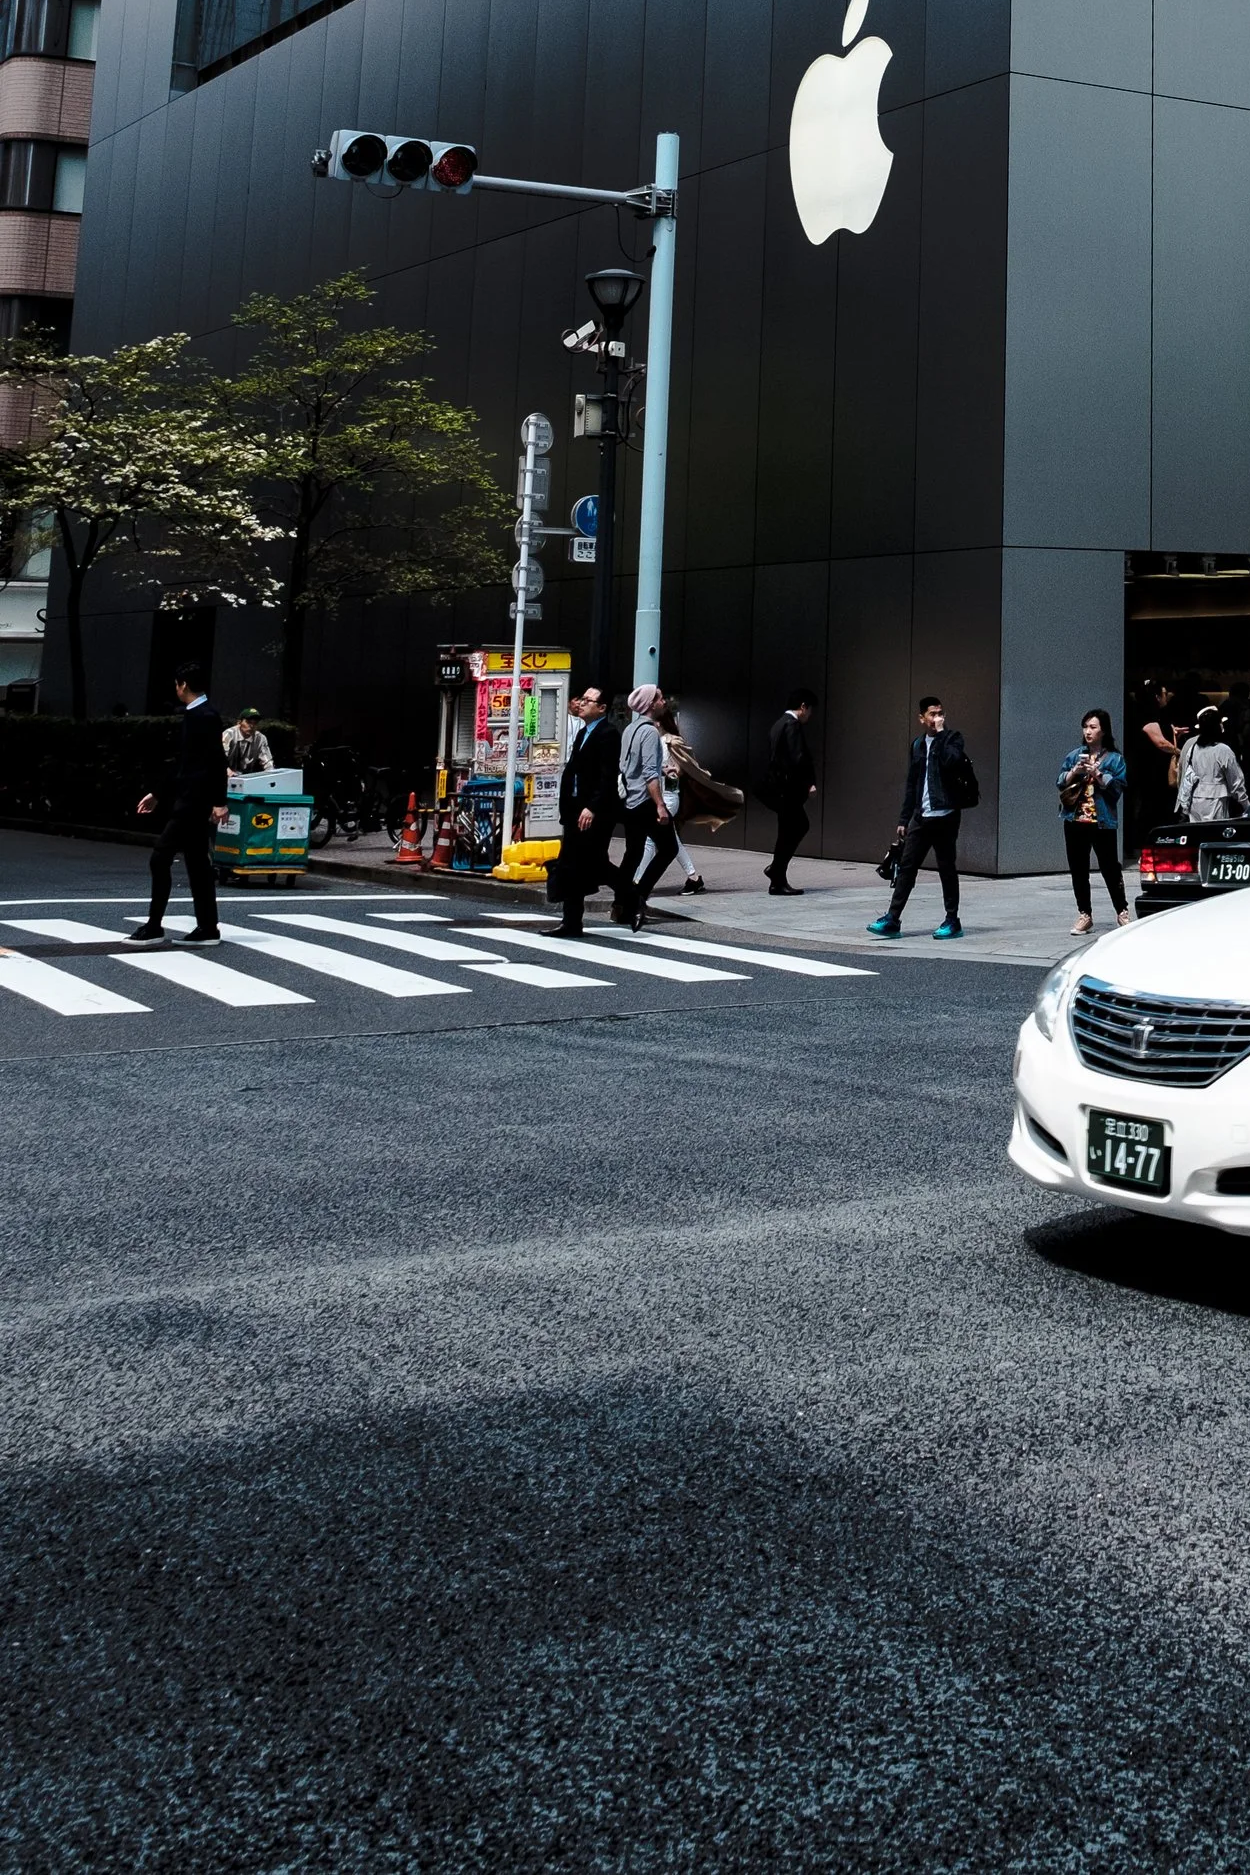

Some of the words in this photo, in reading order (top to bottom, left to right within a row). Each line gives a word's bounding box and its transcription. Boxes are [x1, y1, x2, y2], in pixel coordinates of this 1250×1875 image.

[501, 653, 548, 669] 宝くじ
[1219, 864, 1250, 880] 13-00
[1104, 1138, 1161, 1182] 14-77
